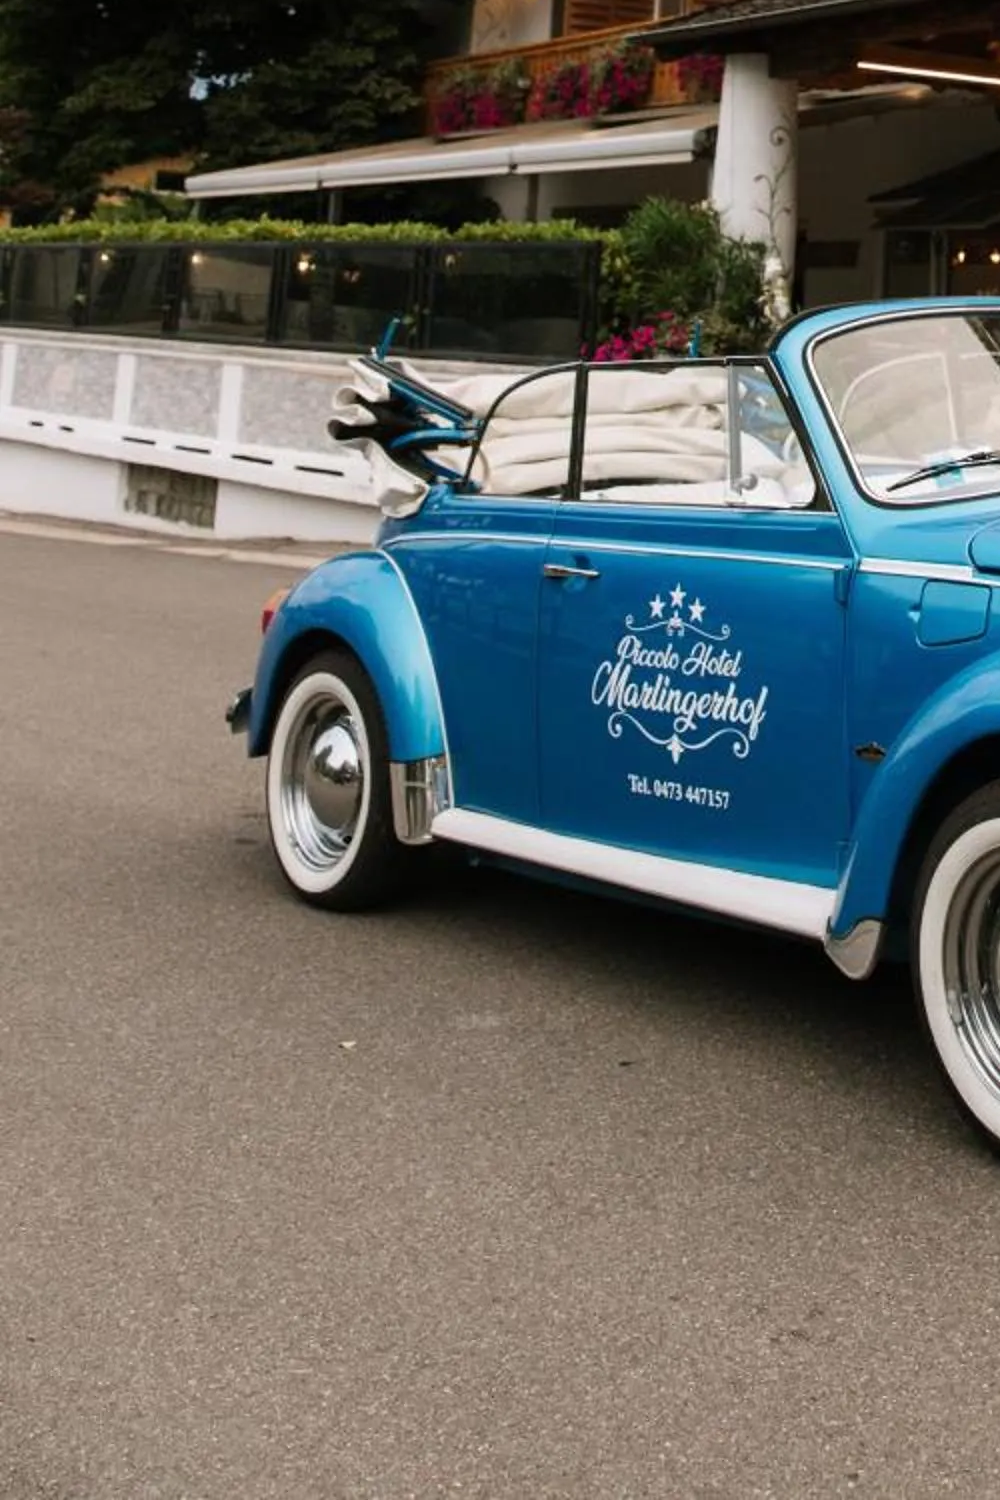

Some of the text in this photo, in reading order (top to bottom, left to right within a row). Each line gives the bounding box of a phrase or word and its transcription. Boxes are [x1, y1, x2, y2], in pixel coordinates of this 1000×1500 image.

[617, 634, 742, 677] Piccolo Hotel
[591, 661, 769, 741] Marlingerhof
[627, 773, 730, 810] Tel. 0473 447157
